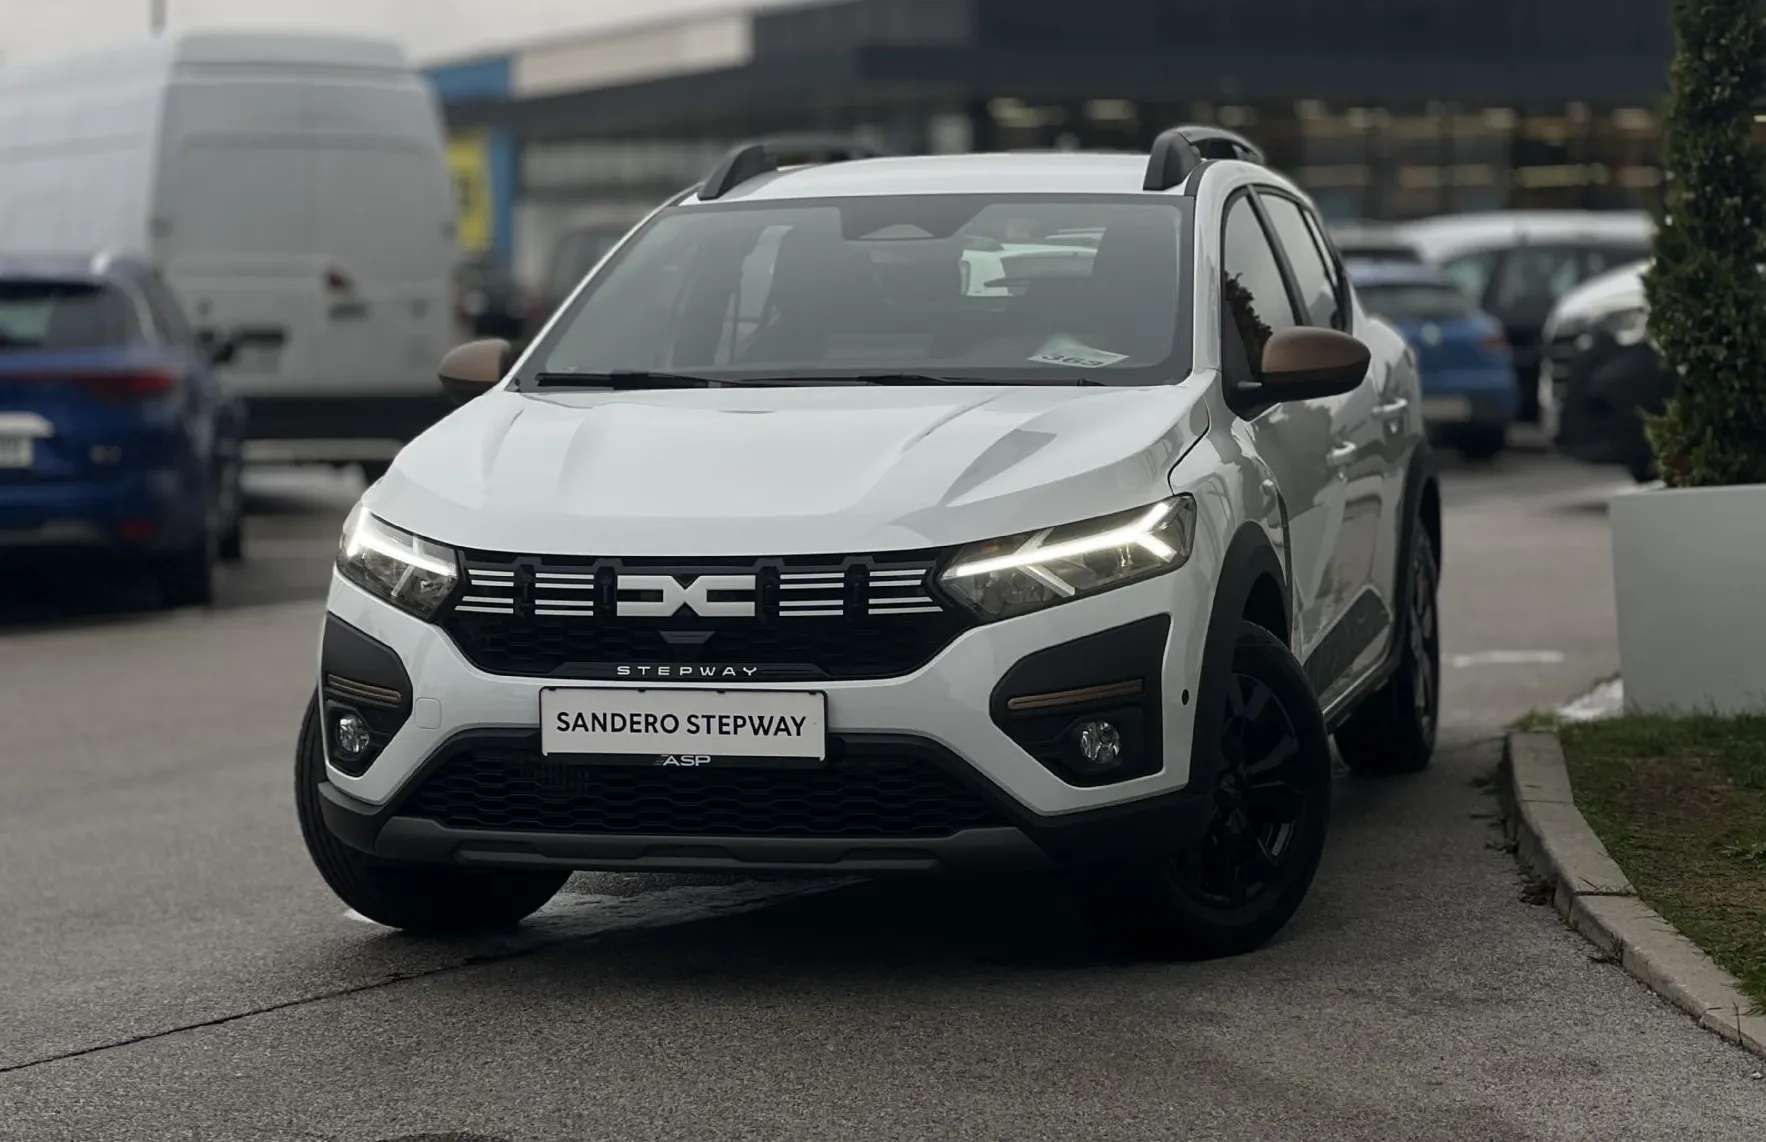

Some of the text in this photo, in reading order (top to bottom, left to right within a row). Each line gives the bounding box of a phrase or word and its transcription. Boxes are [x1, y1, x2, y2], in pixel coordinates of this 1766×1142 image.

[616, 665, 758, 677] STEPWAY
[556, 711, 807, 737] SANDERO STEPWAY
[661, 754, 712, 767] ASP
